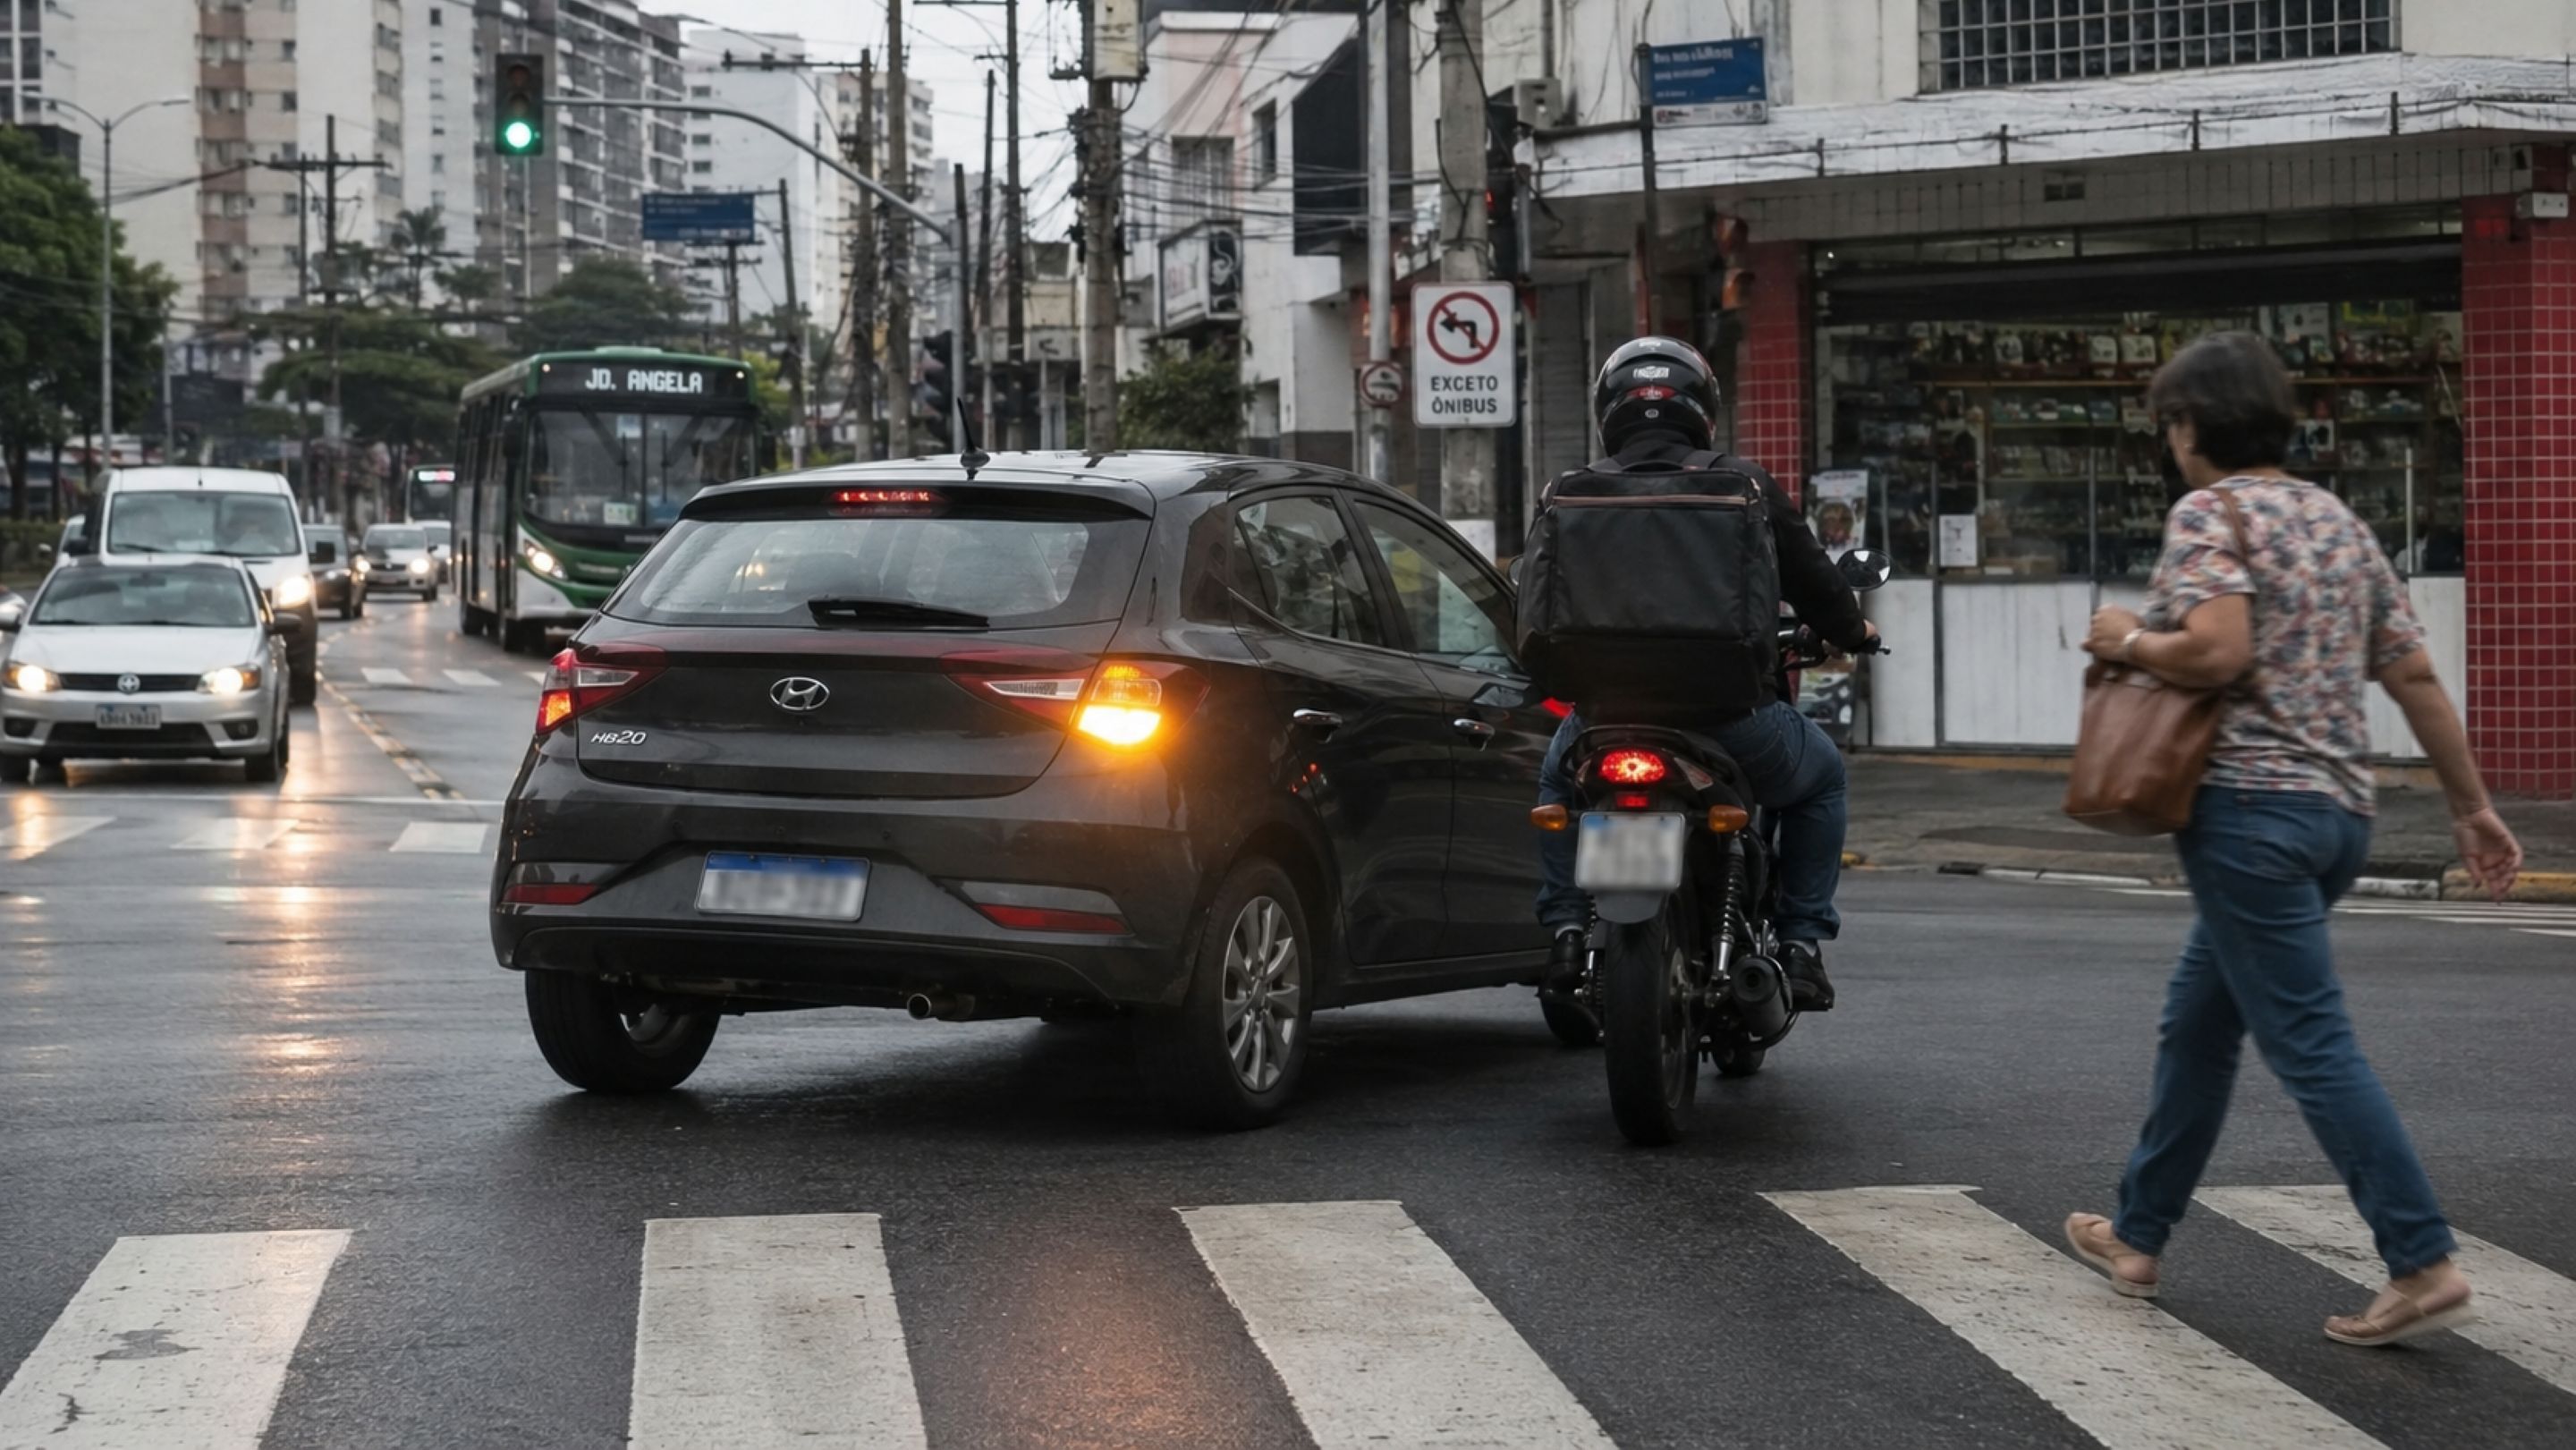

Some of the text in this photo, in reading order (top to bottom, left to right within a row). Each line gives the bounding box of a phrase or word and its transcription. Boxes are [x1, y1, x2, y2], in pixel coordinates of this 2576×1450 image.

[584, 368, 703, 394] JD. ANGELA
[1430, 376, 1498, 391] EXCETO
[1431, 396, 1497, 414] ÔNIBUS
[590, 730, 647, 744] HB20
